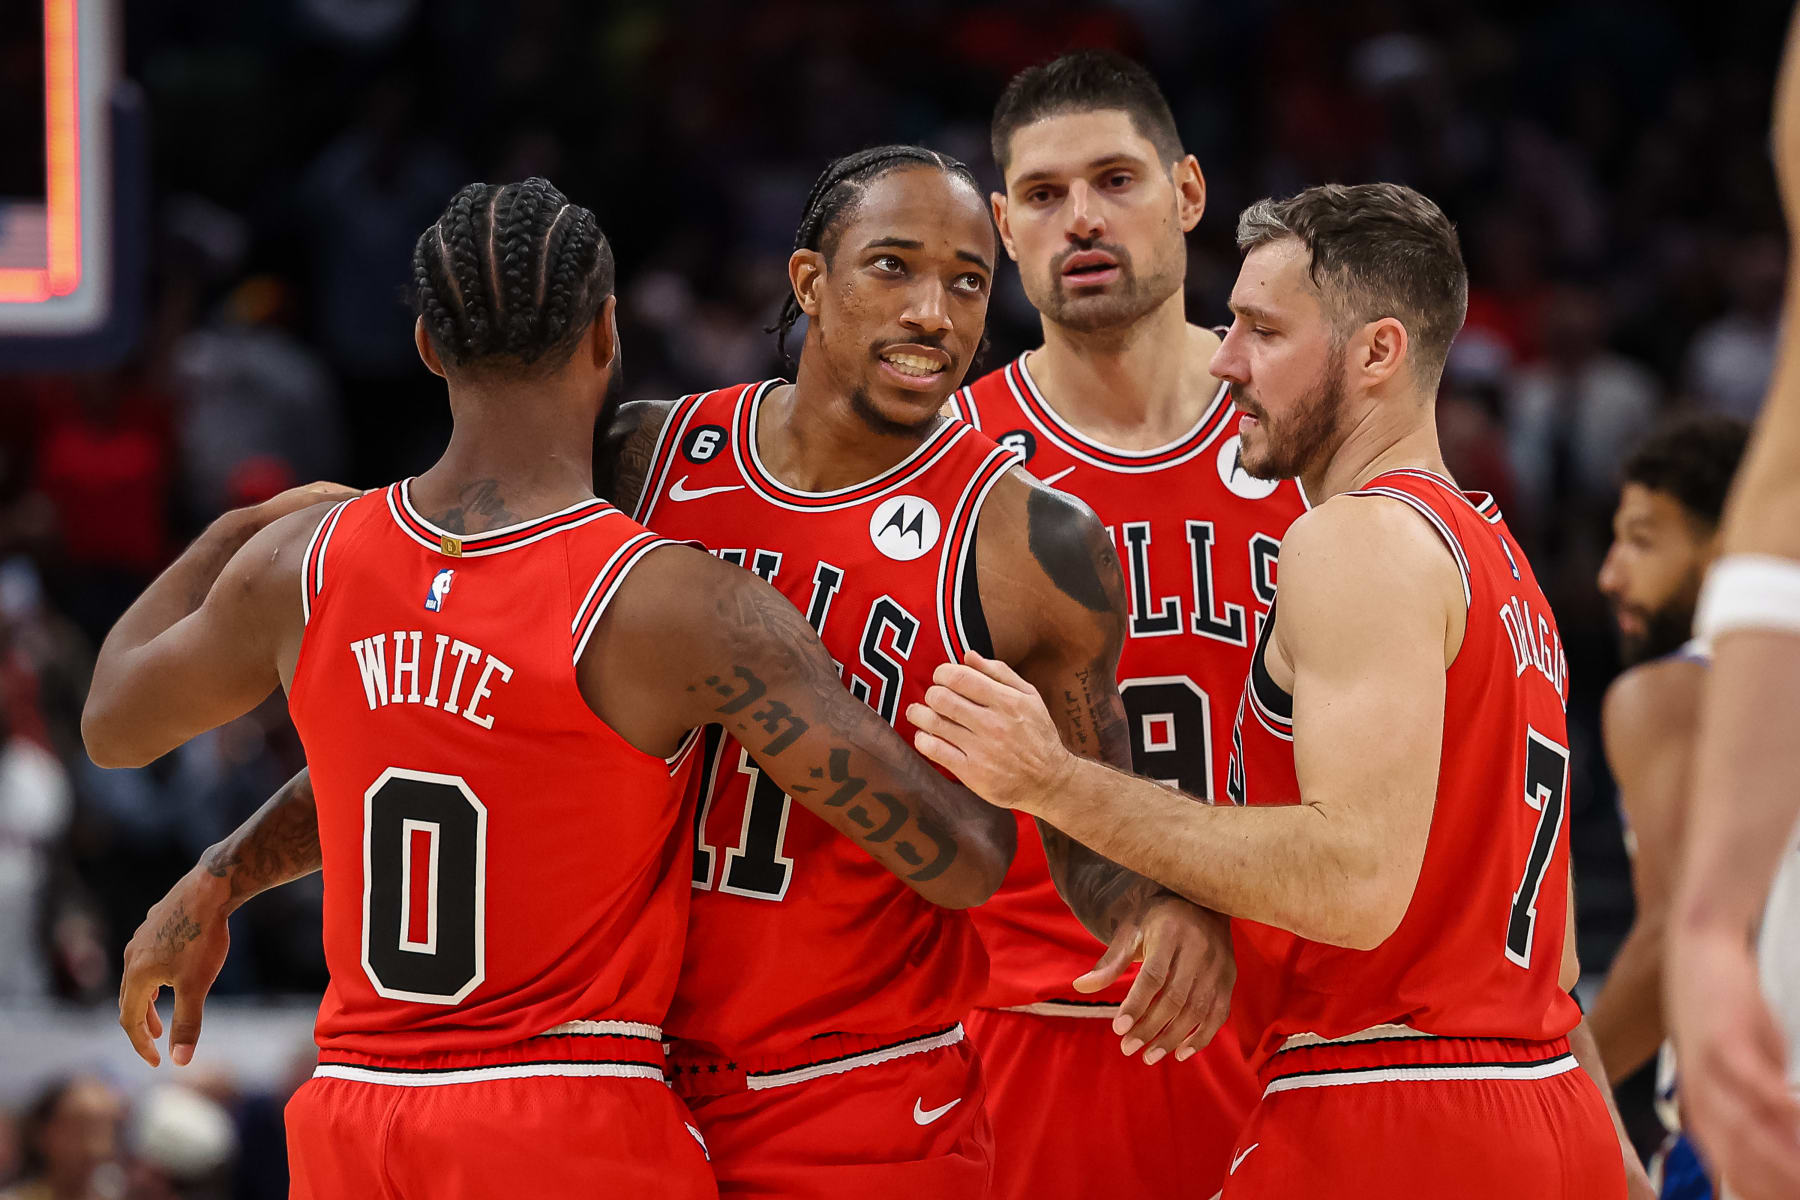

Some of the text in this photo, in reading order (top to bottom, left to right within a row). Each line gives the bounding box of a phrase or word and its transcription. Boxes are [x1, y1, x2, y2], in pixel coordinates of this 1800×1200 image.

[700, 428, 722, 460] 6
[350, 630, 514, 730] WHITE
[361, 766, 487, 1005] 0
[1505, 723, 1570, 970] 7
